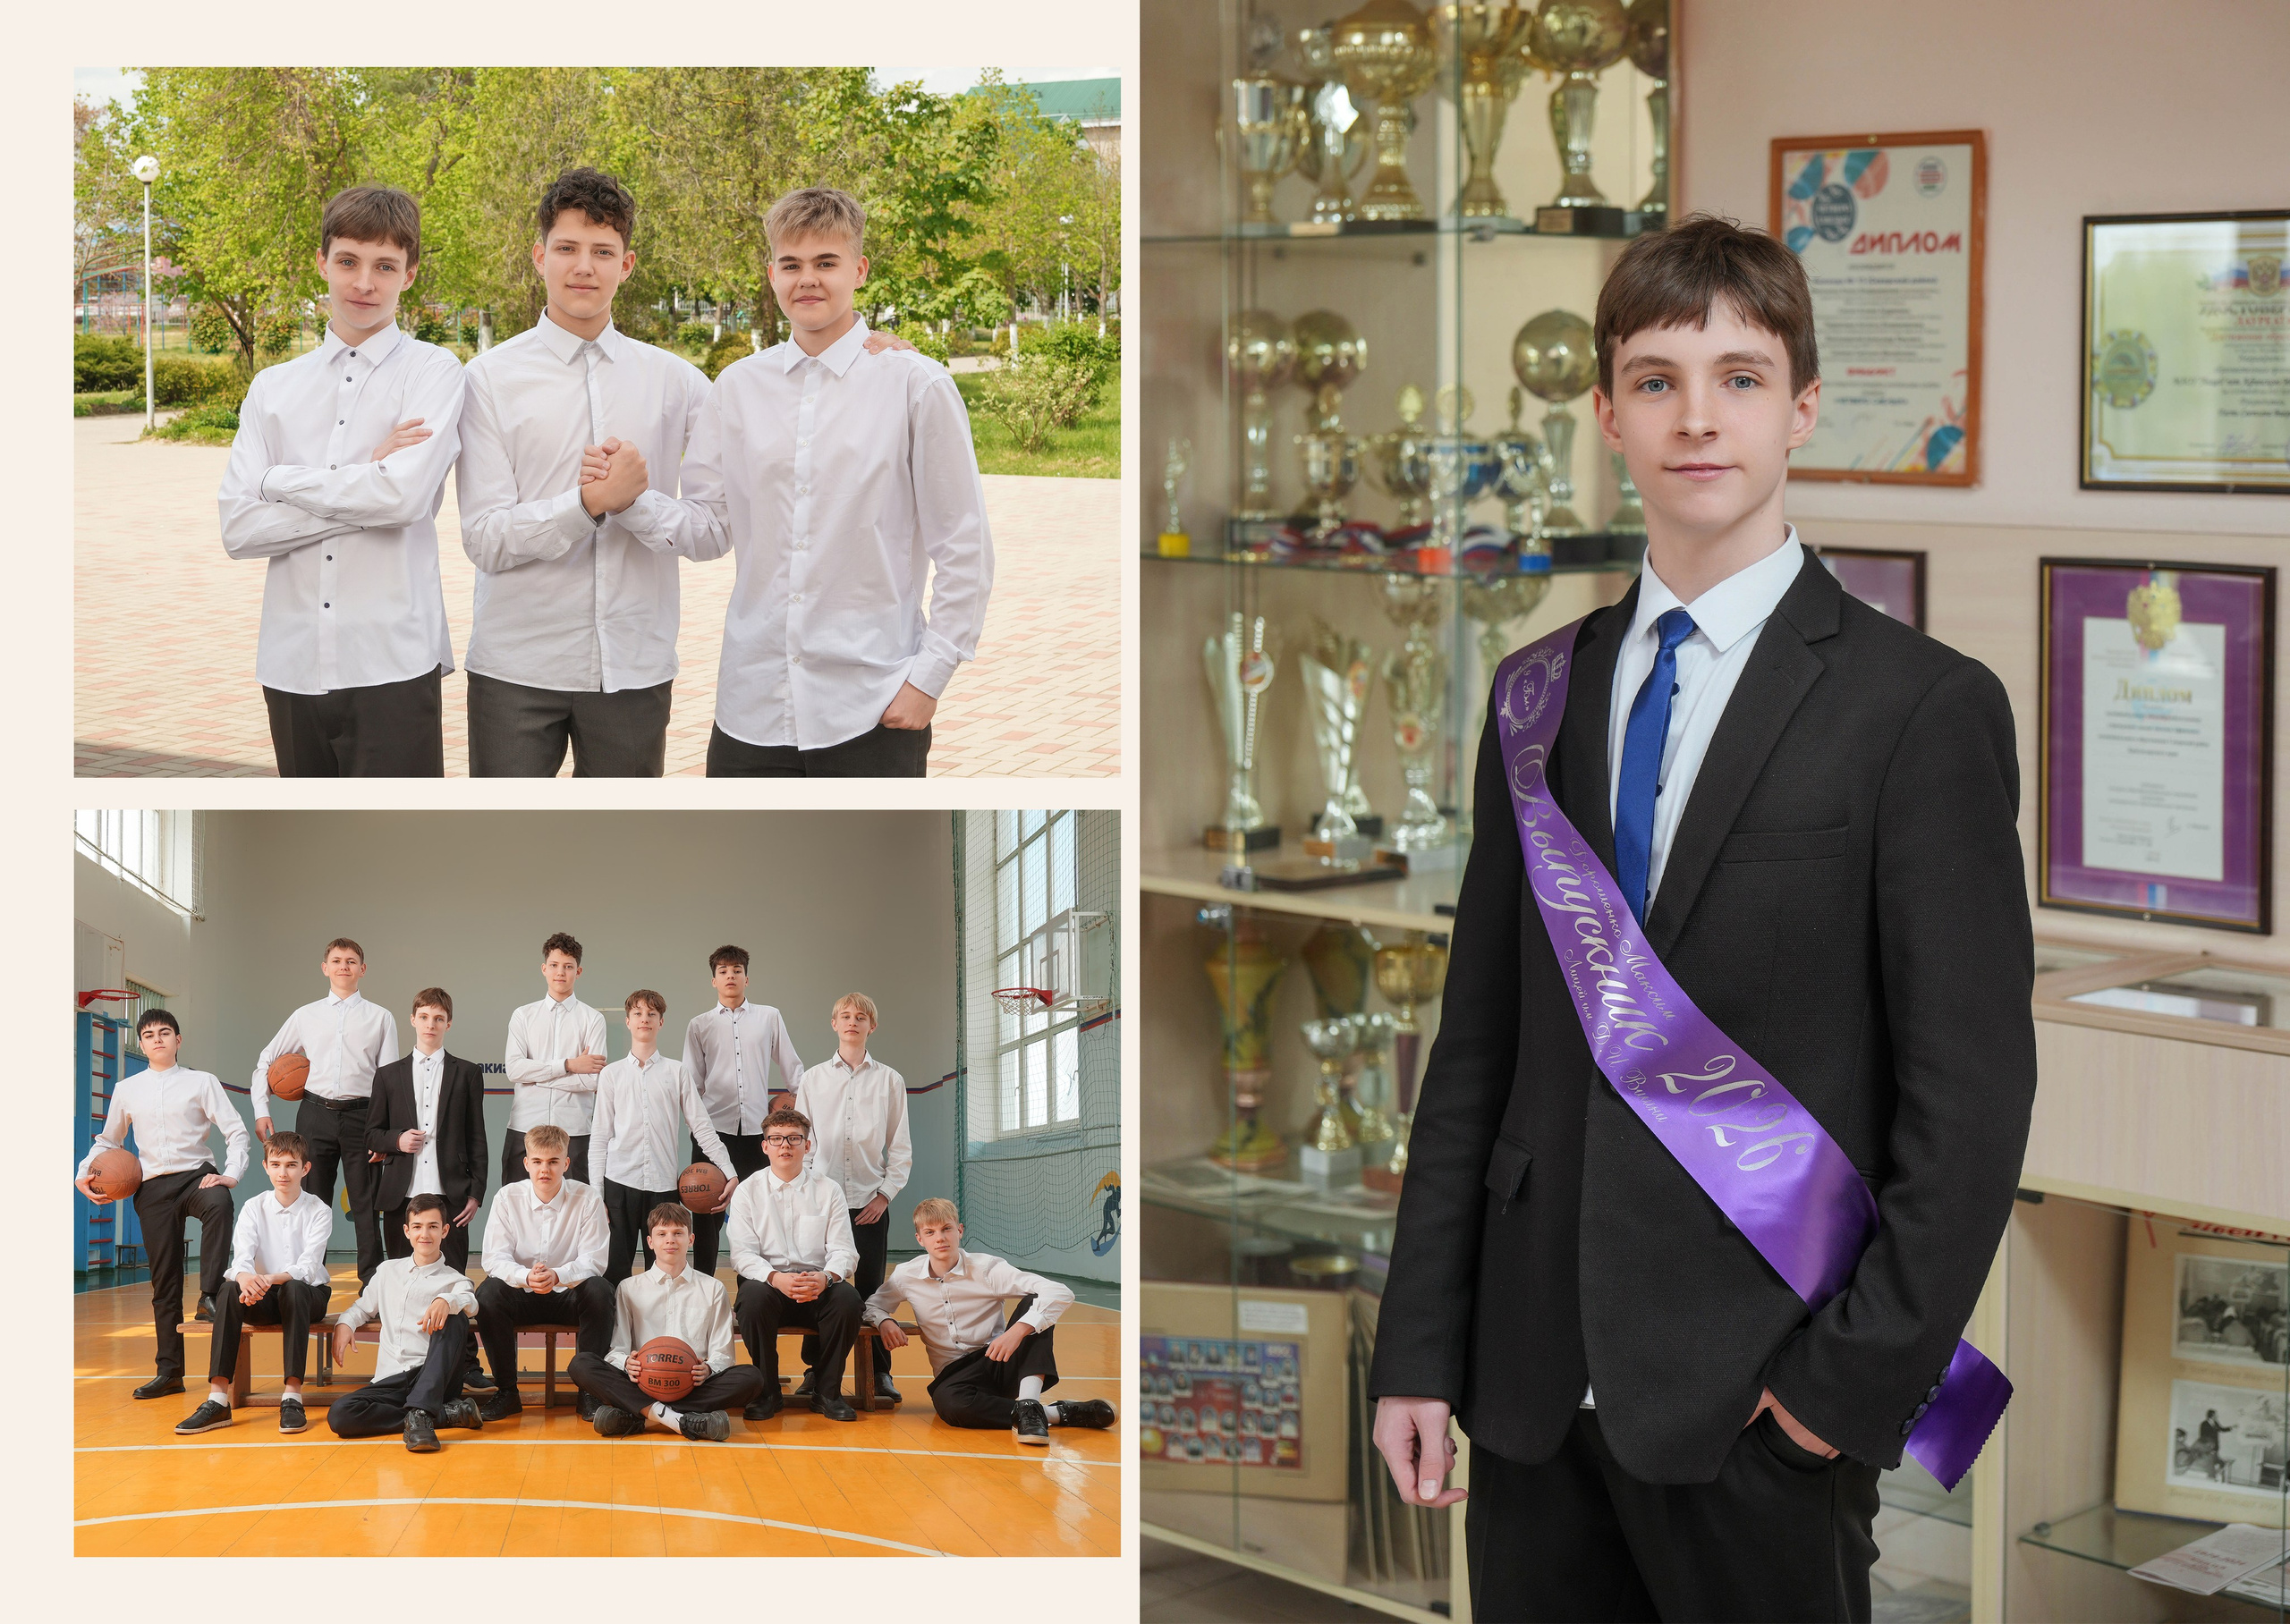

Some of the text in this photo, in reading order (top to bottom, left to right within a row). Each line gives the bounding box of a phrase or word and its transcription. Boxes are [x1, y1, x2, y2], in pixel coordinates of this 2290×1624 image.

[1849, 231, 1963, 256] ДИПЛОМ
[2113, 677, 2192, 705] Диплом
[1569, 836, 1676, 1021] Дорошенко Максим
[1510, 744, 1816, 1171] Выпускник 2026
[1564, 949, 1588, 1002] Лицей
[1620, 1067, 1668, 1123] Вишни
[681, 1184, 710, 1193] TORRES
[646, 1353, 683, 1365] TORRES
[648, 1377, 680, 1387] BM 300
